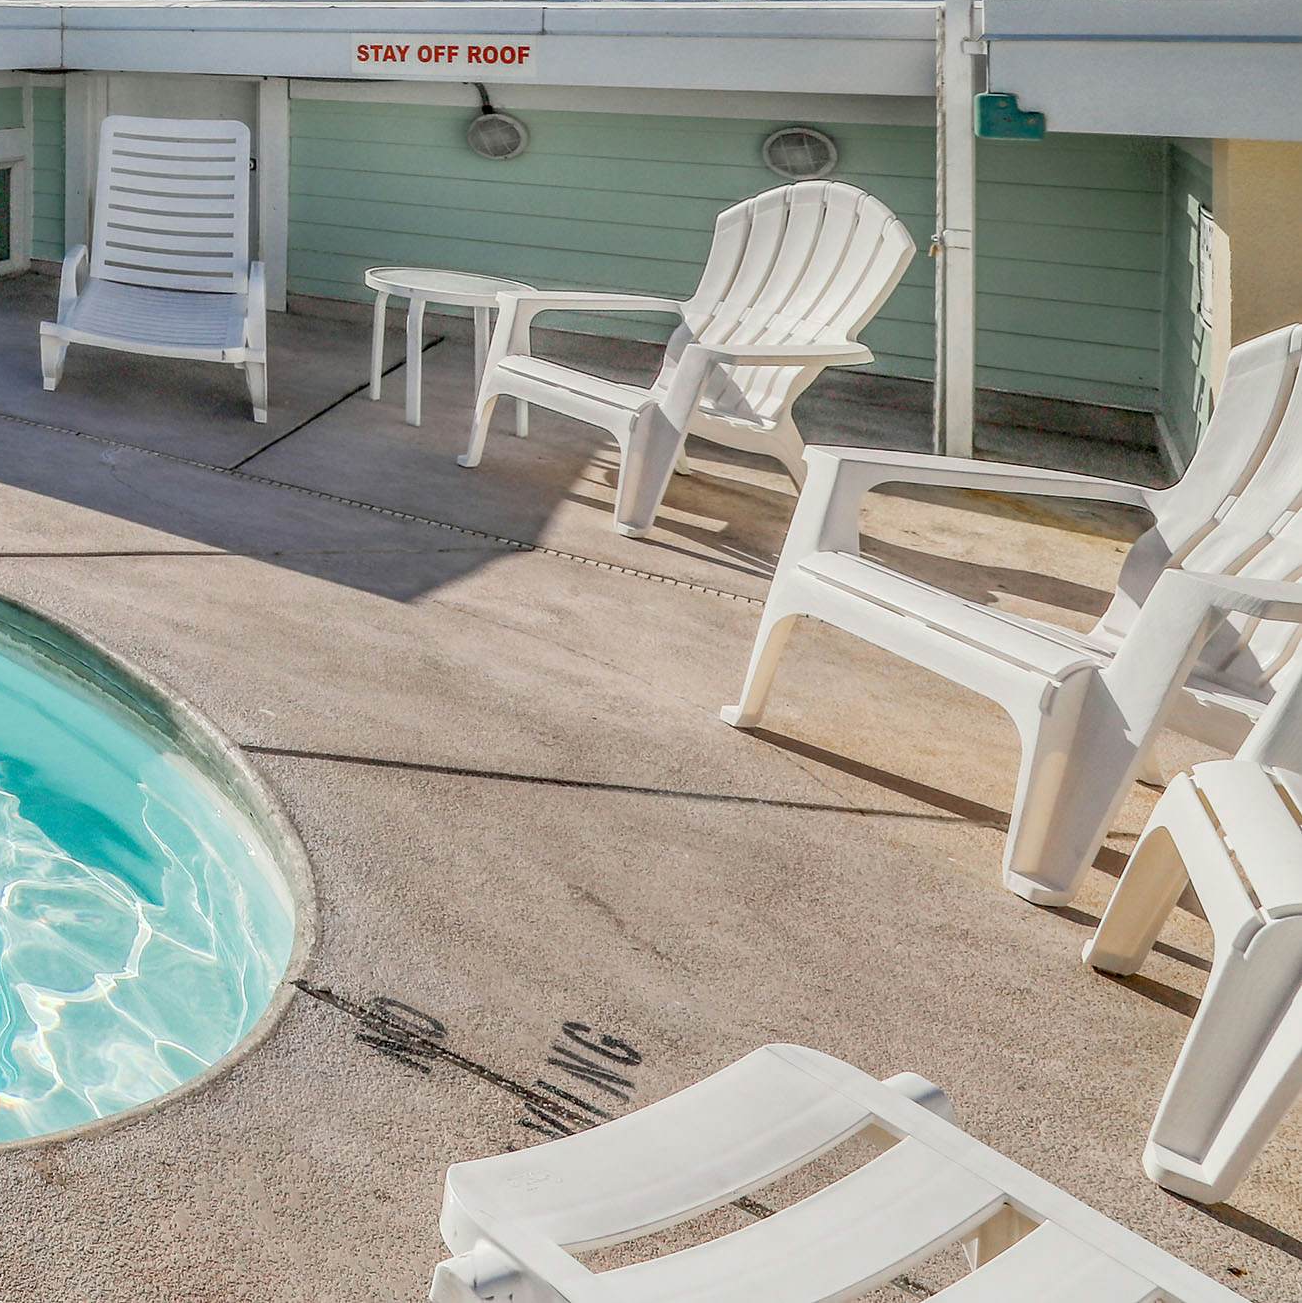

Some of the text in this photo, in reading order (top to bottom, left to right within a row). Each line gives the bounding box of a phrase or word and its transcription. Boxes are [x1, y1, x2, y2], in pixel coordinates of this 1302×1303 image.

[357, 44, 531, 65] STAY OFF ROOF
